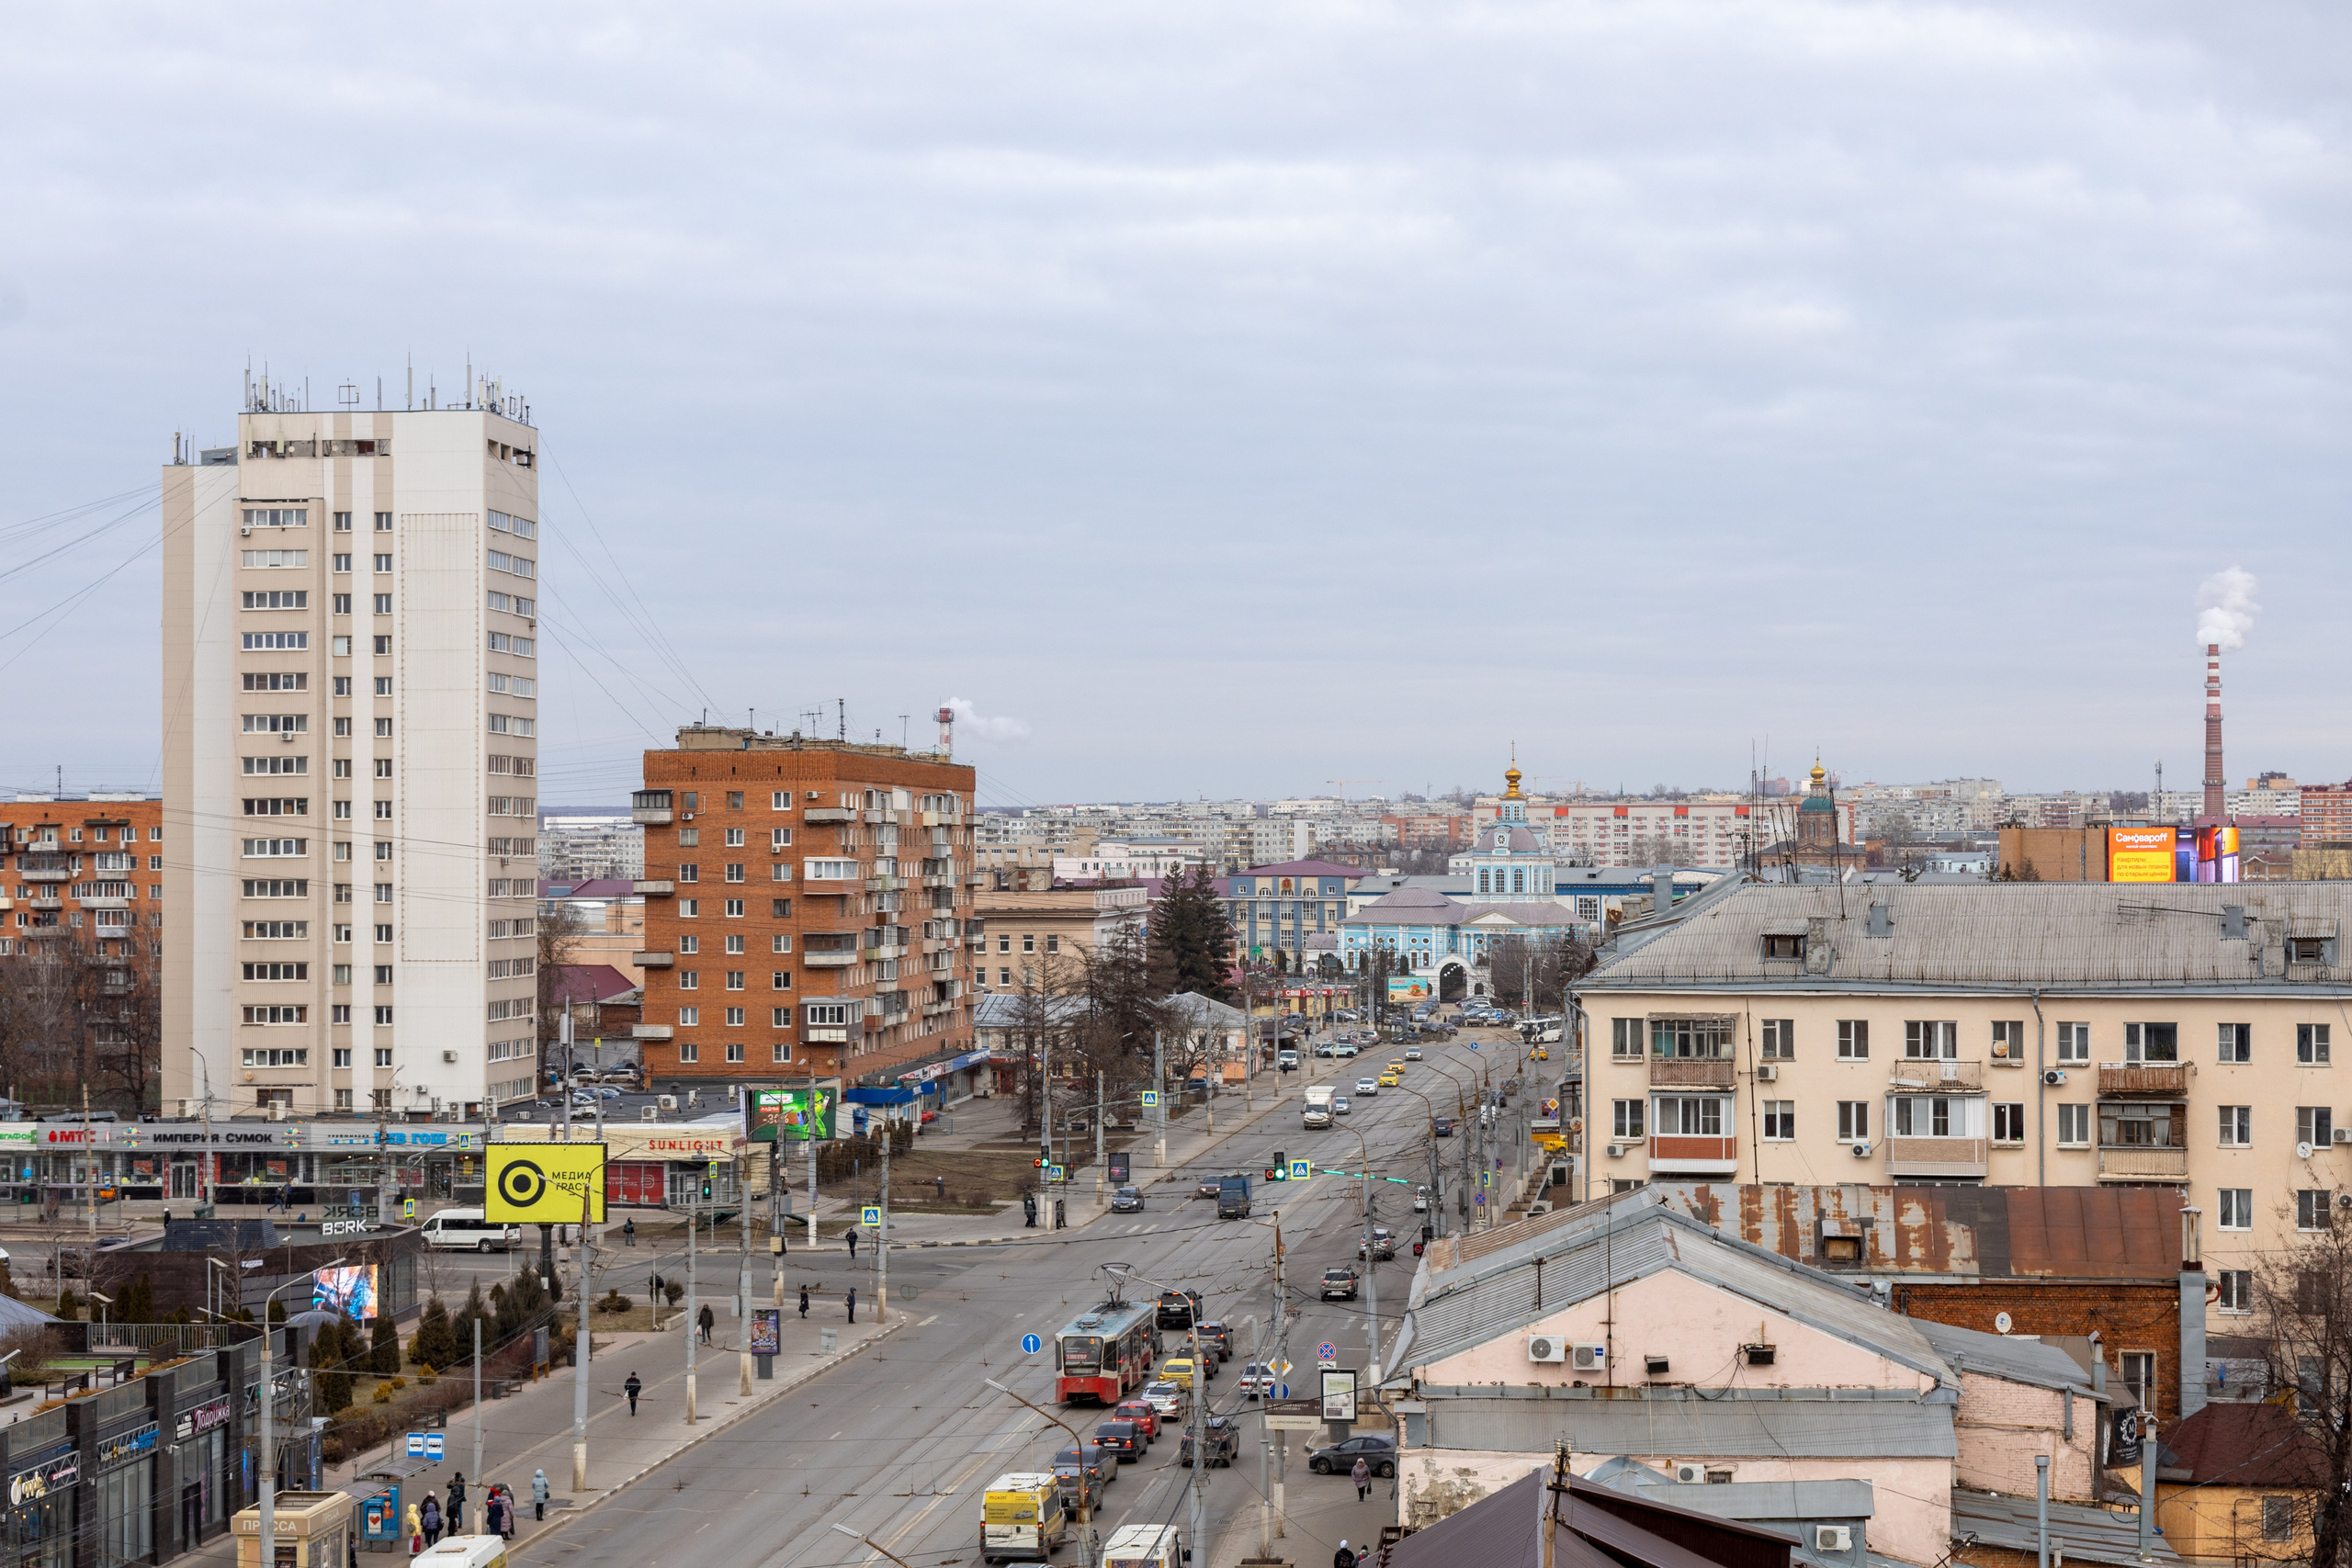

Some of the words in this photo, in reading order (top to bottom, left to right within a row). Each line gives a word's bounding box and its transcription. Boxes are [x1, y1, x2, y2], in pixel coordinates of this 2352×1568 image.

[60, 1130, 96, 1143] МТС
[411, 1133, 447, 1145] ГОШ
[649, 1139, 723, 1151] SUNLIGHT
[551, 1171, 592, 1180] МЕДИА
[556, 1182, 589, 1191] ТРАС
[322, 1219, 368, 1235] BORK
[243, 1519, 298, 1532] ПРСА
